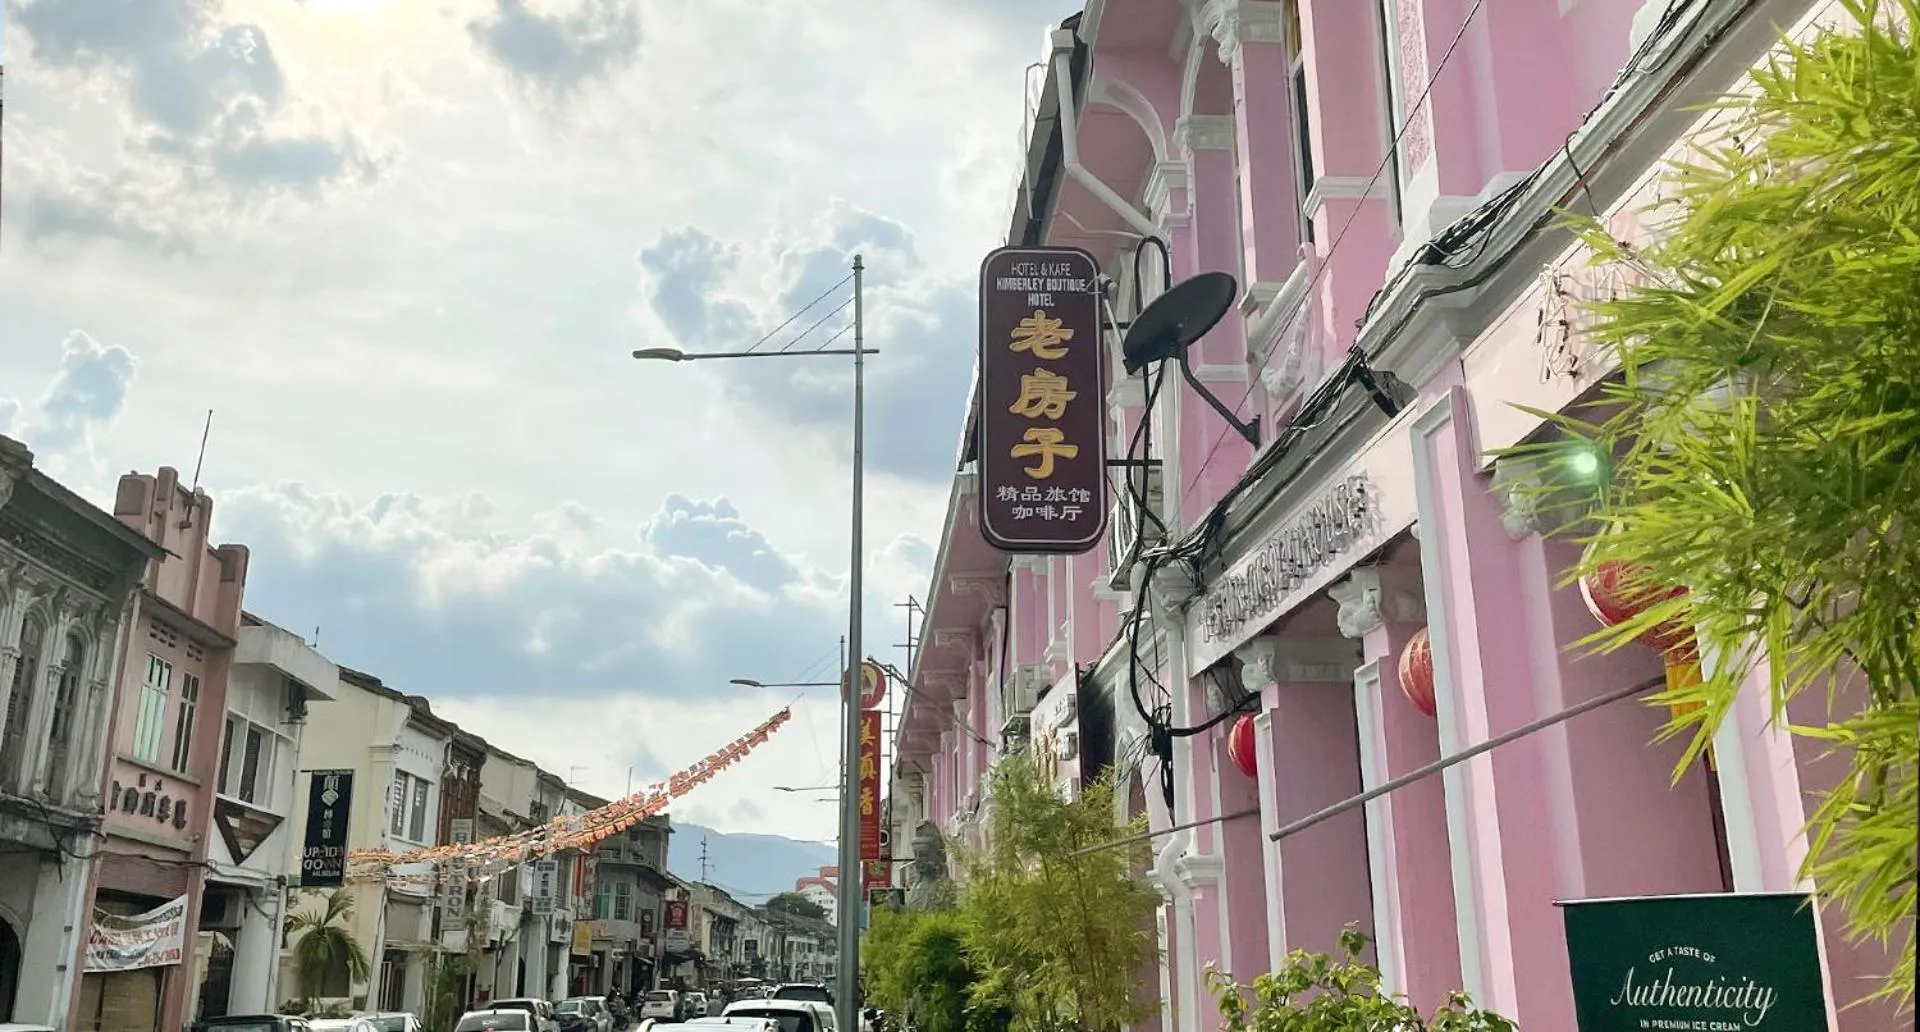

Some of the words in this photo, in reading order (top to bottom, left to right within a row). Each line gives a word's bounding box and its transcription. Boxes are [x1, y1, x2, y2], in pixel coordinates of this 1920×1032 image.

[1011, 263, 1039, 276] HOTEL
[1041, 263, 1048, 276] &
[1049, 263, 1071, 277] KAFE
[996, 277, 1044, 291] KIMBERLEY
[1046, 279, 1087, 292] BOUTIQUE
[1027, 293, 1055, 307] HOTEL
[1008, 309, 1079, 480] 老房子
[996, 485, 1091, 503] 精品旅馆
[1012, 504, 1083, 521] 咖啡厅
[1649, 949, 1665, 963] GET
[1667, 947, 1673, 957] A
[1673, 946, 1700, 958] TASTE
[1703, 952, 1716, 963] OF
[1610, 966, 1778, 1027] Authenticity
[1640, 1019, 1650, 1029] IN
[1652, 1020, 1690, 1030] PREMIUM
[1692, 1020, 1707, 1031] ICE
[1709, 1021, 1741, 1032] CREAM
